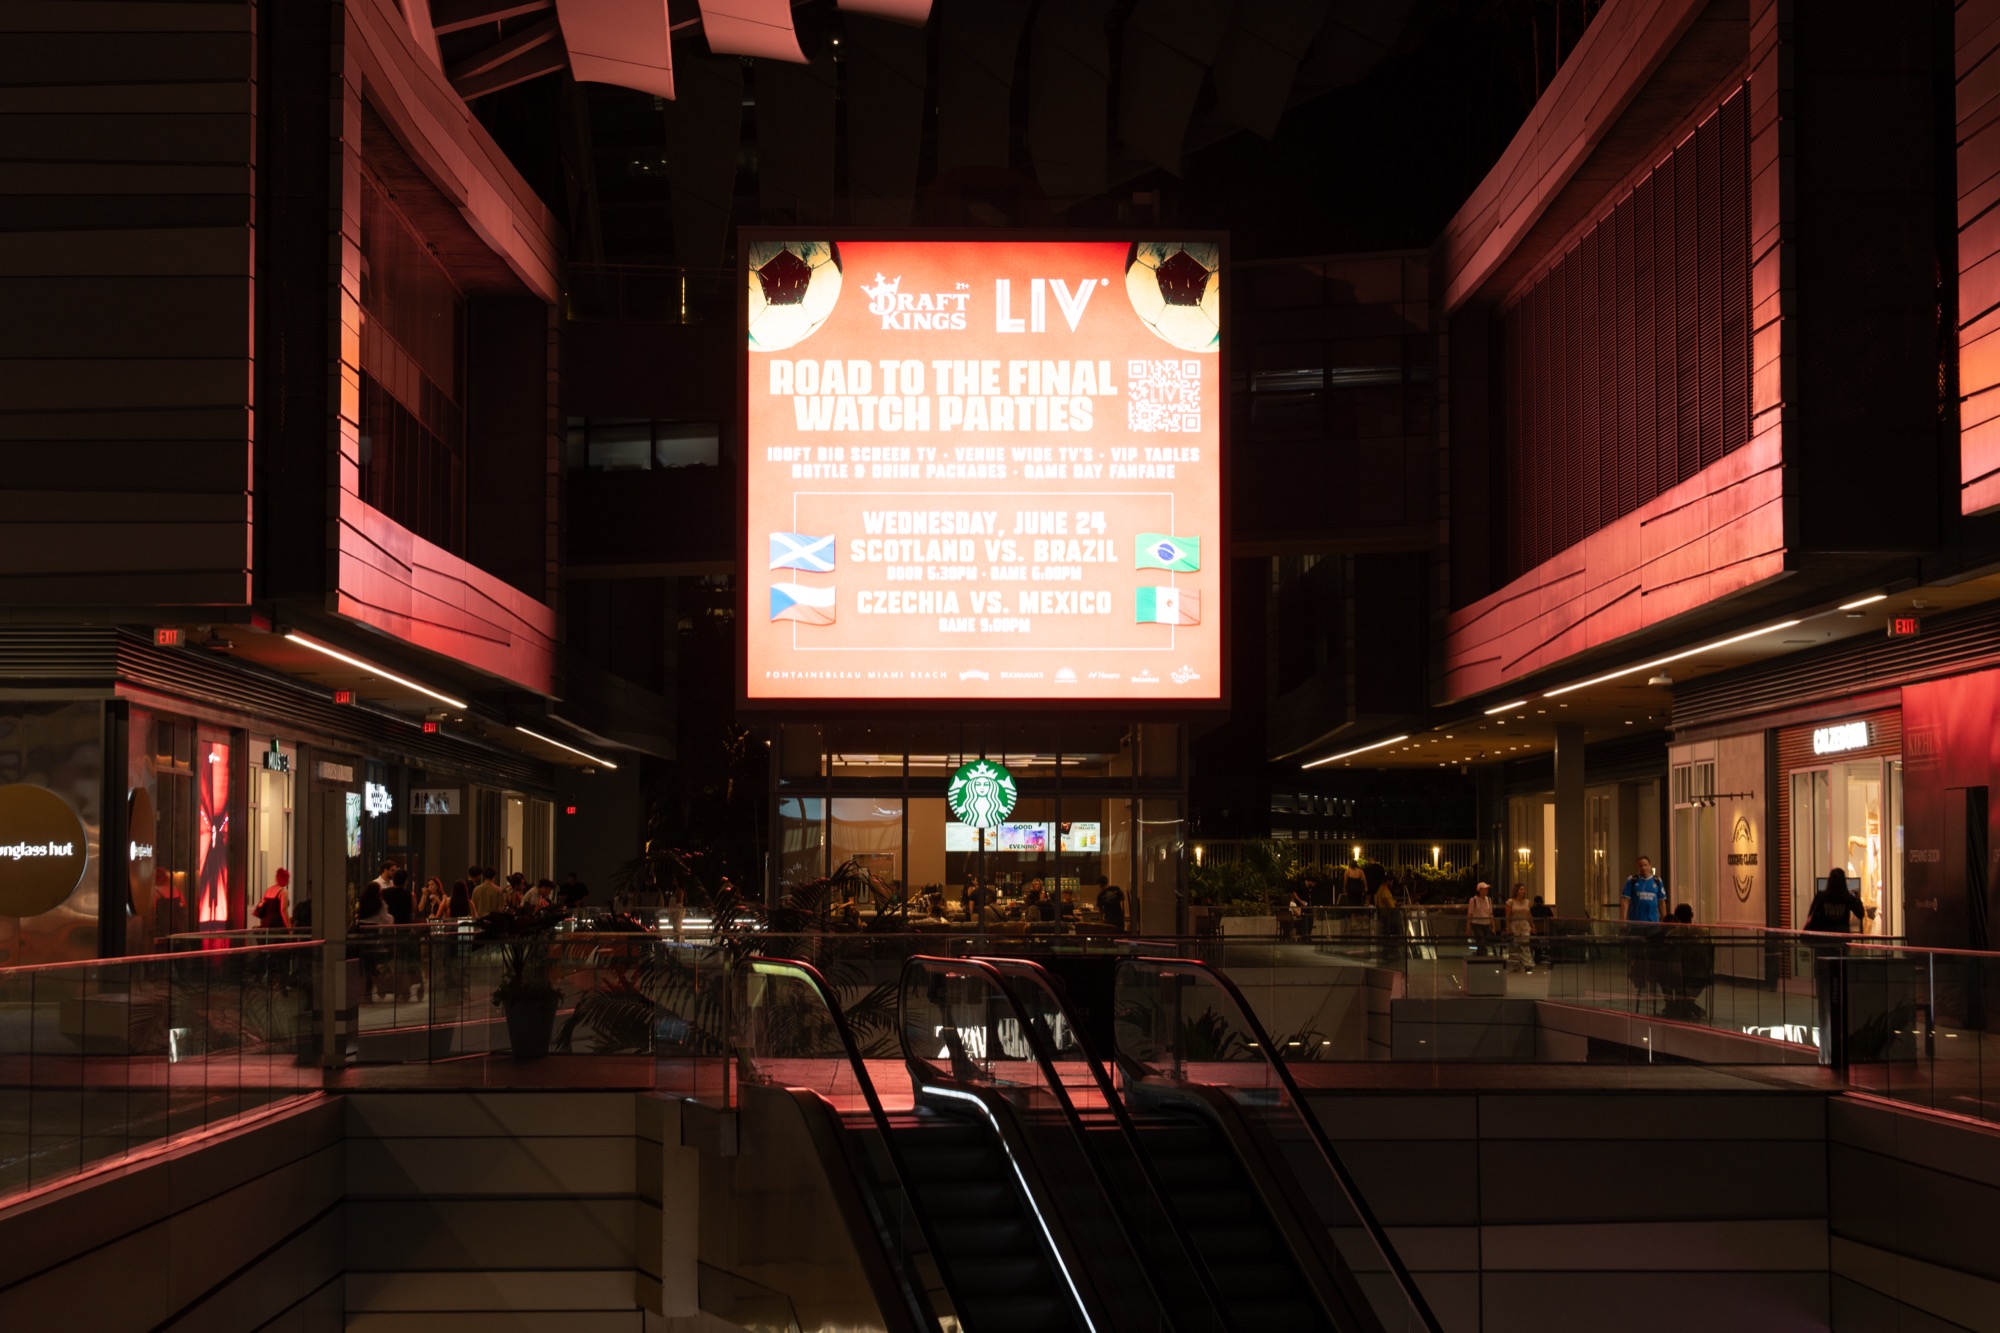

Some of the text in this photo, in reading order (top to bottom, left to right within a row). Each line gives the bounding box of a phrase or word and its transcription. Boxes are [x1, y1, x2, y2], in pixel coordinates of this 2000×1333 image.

[955, 282, 970, 290] 21+
[868, 292, 970, 316] DRAFT
[995, 278, 1098, 334] LIV
[880, 312, 967, 331] KINGS
[769, 359, 1118, 396] ROAD TO THE FINAL
[793, 396, 1094, 432] WATCH PARTIES
[767, 447, 1200, 462] 100FT BIG SCREEN TV VENUE WIDE TV'S VIP TABLES
[791, 463, 849, 479] BOTTLE
[871, 463, 920, 479] DRINK
[926, 463, 1007, 479] PACKAGES
[1023, 463, 1068, 479] GAME
[1073, 463, 1103, 479] DAY
[1109, 463, 1176, 479] FANFARE
[862, 510, 1107, 538] WEDNESDAY, JUNE 24
[850, 539, 1119, 563] SCOTLAND VS. BRAZIL
[886, 565, 923, 581] DOOR
[926, 565, 978, 581] 5:30PM
[990, 565, 1028, 581] GAME
[856, 590, 1112, 615] CZECHIA VS. MEXICO
[938, 617, 976, 633] GAME
[1895, 618, 1915, 635] EXIT
[159, 629, 178, 645] EXIT
[765, 671, 948, 679] FONTAINEBLEAU MIAMI BEACH
[335, 691, 351, 704] EXIT
[424, 722, 437, 733] EXIT
[49, 841, 74, 857] hut
